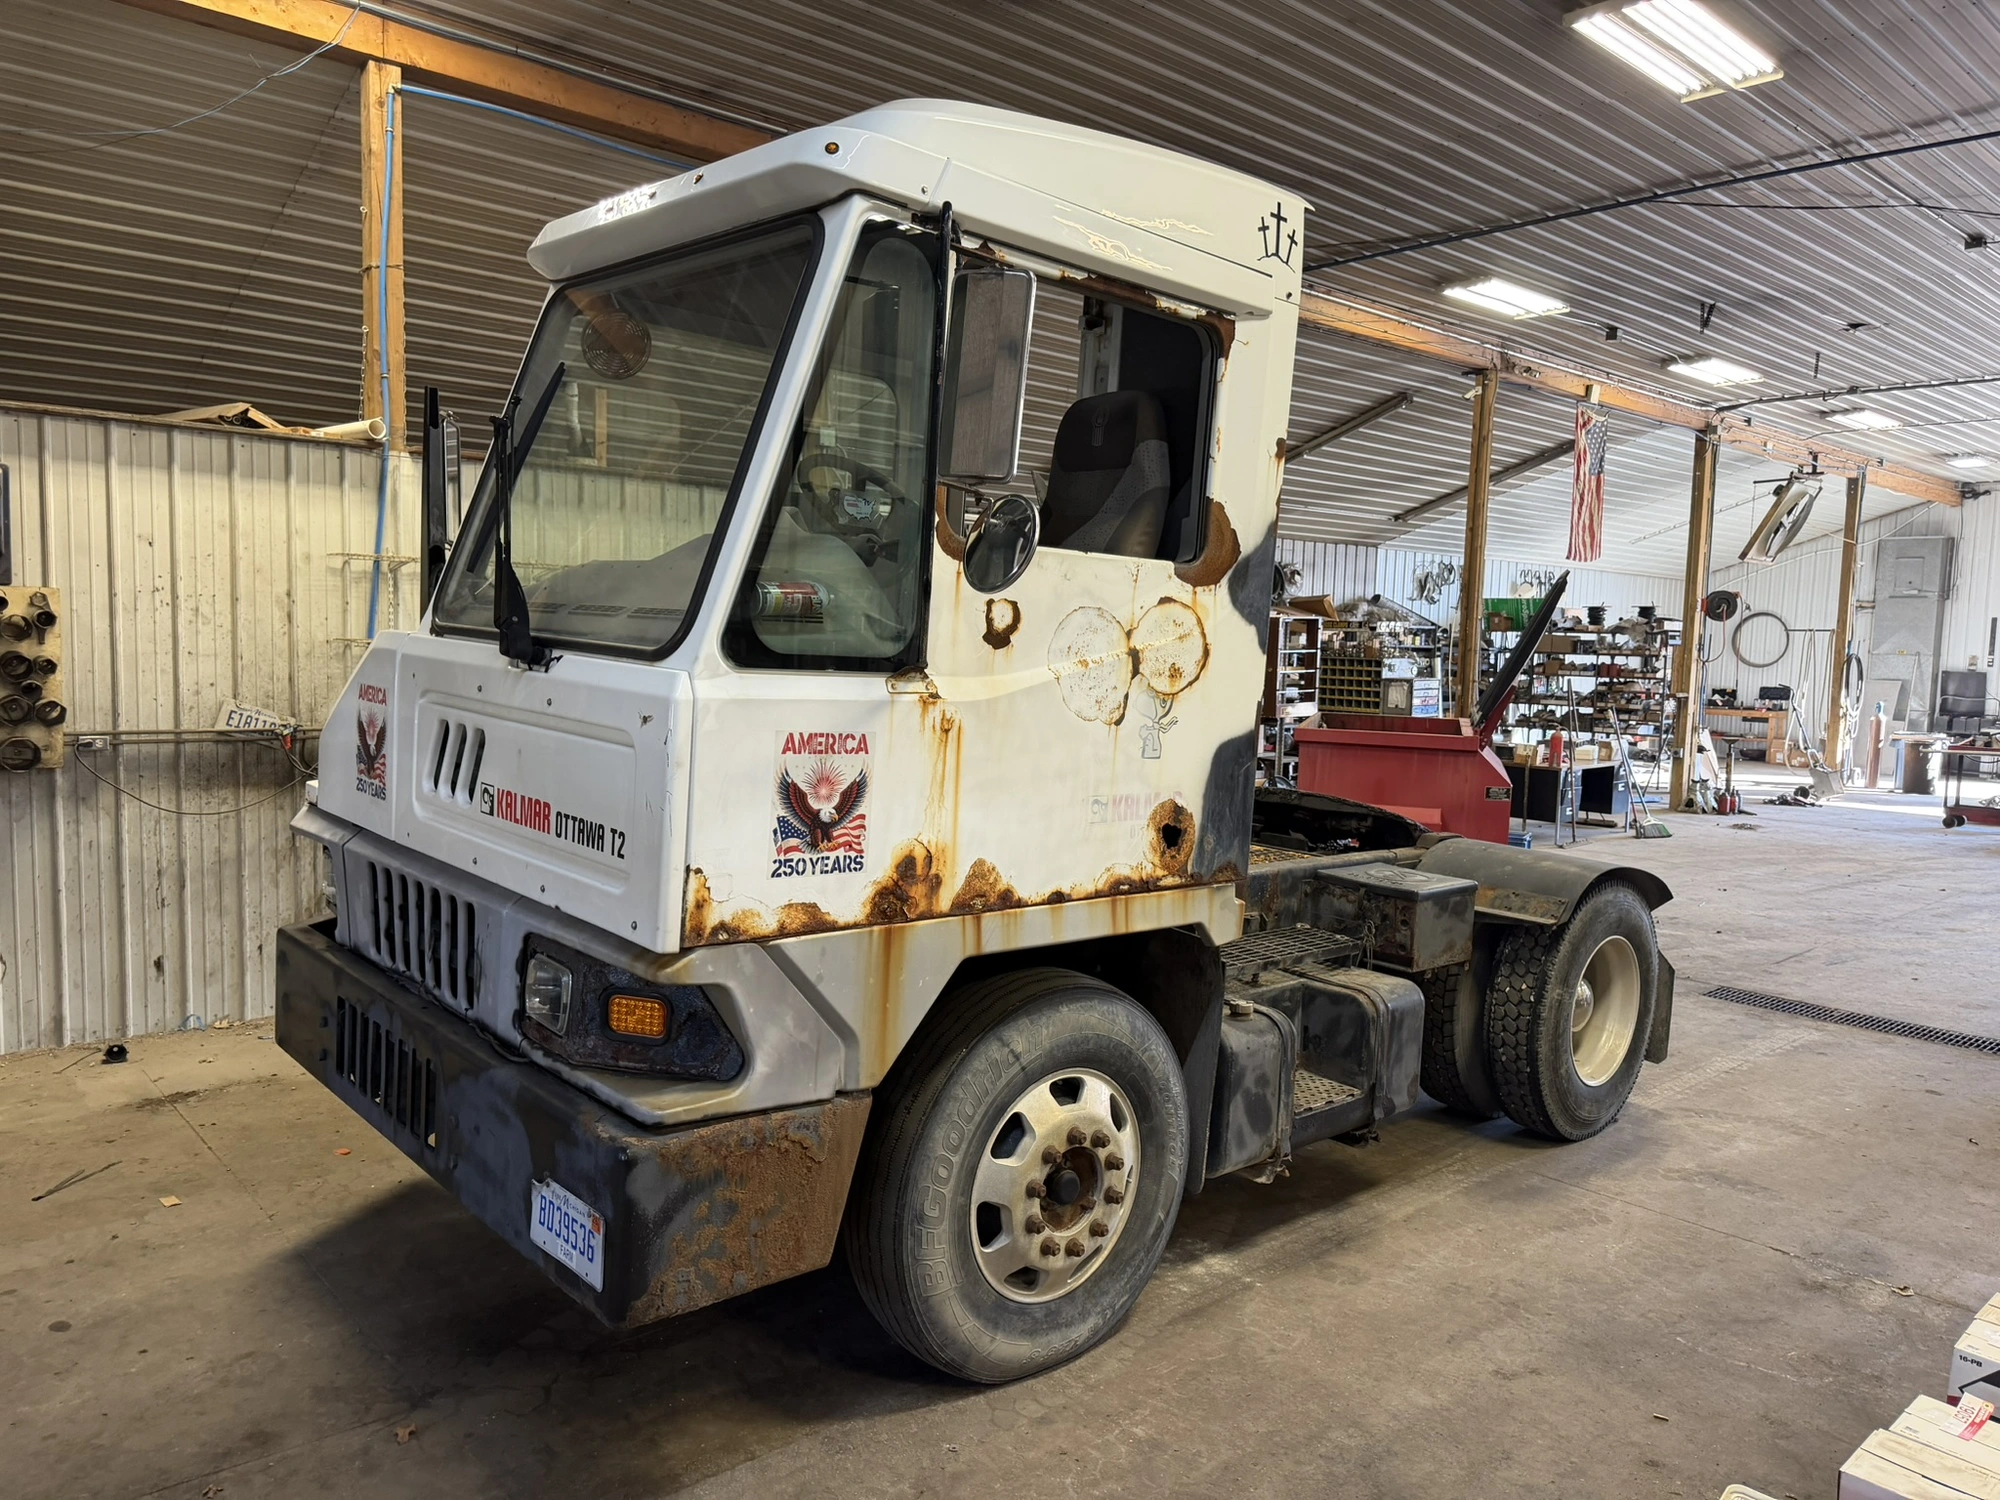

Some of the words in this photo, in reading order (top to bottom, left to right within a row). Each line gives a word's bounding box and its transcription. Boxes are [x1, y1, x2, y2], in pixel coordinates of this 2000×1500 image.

[358, 684, 387, 706] AMERICA
[781, 732, 869, 754] AMERICA
[356, 777, 367, 793] 250
[367, 782, 387, 801] YEARS
[497, 788, 551, 835] KALMAR
[555, 810, 605, 852] OTTAWA
[610, 827, 626, 860] T2
[771, 857, 806, 878] 250
[809, 855, 864, 876] YEARS
[914, 1020, 1044, 1297] BFGoodrich
[538, 1194, 596, 1264] BD39536
[560, 1244, 574, 1261] FARM
[1958, 1354, 1983, 1368] 16-PB
